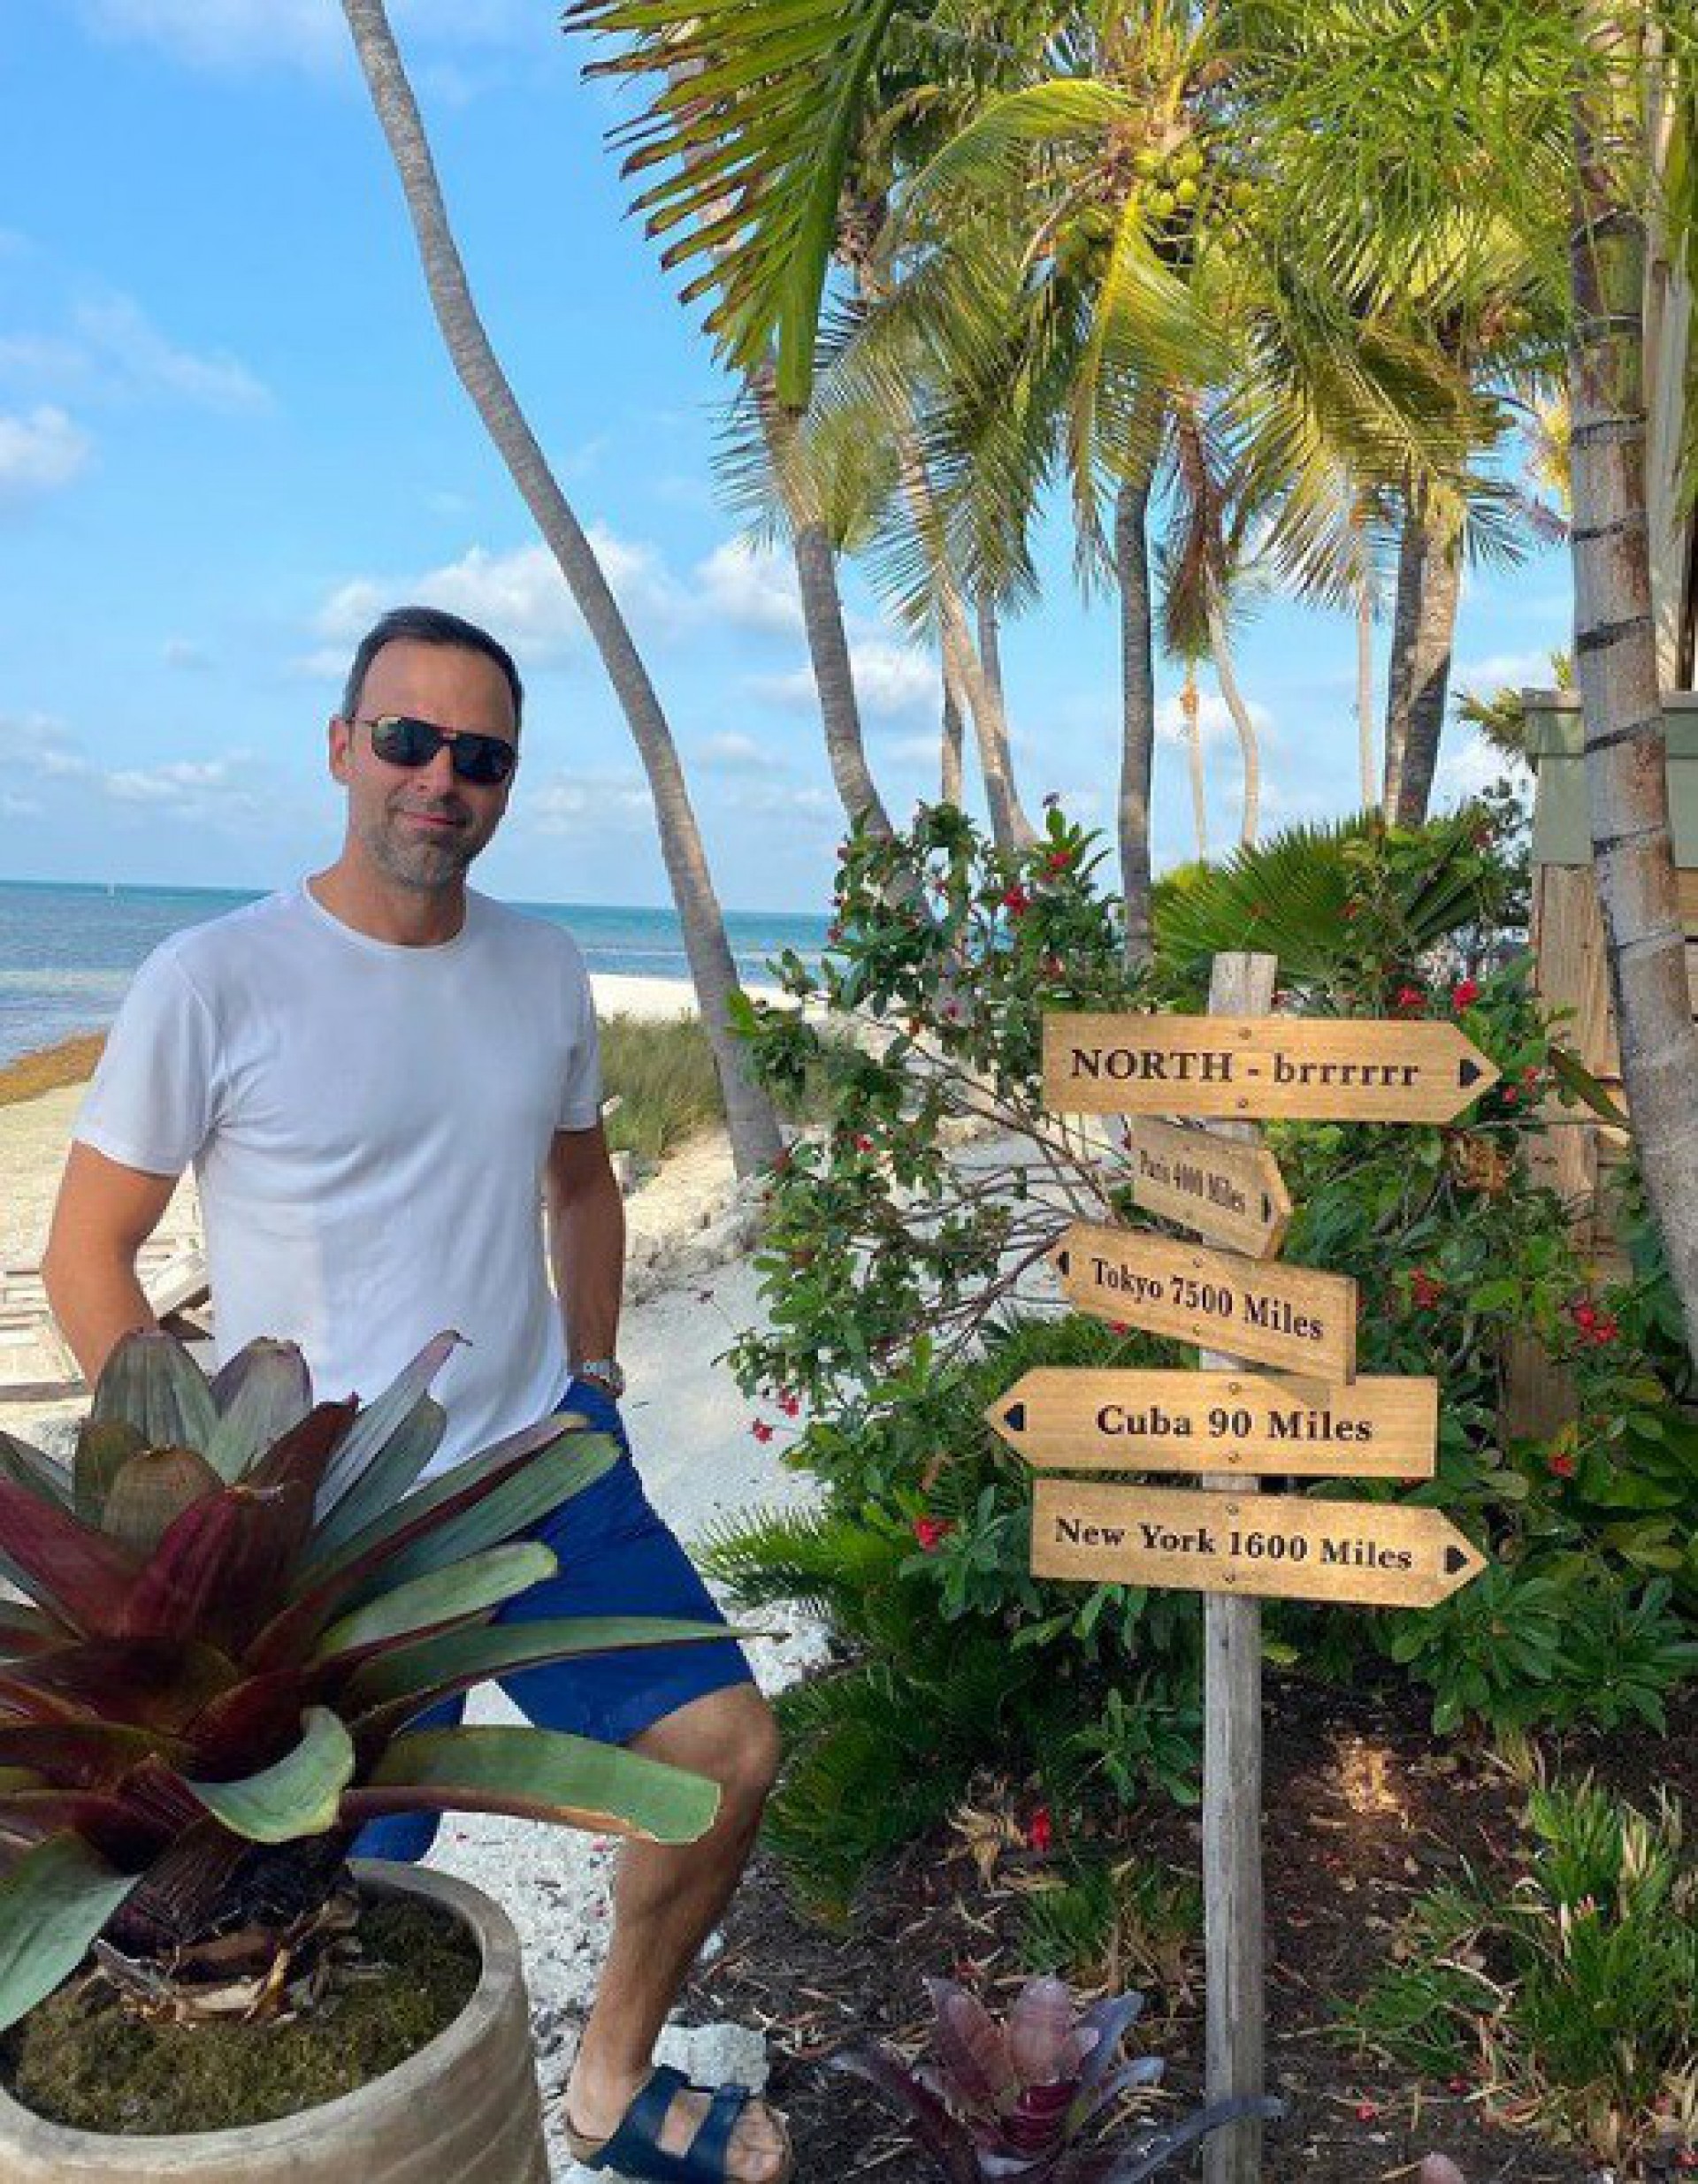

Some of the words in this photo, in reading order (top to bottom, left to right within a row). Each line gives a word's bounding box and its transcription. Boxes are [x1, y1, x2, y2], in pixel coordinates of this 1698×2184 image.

[1071, 1049, 1233, 1082] NORTH
[1274, 1052, 1419, 1086] brrrrrr
[1208, 1172, 1246, 1215] Miles
[1091, 1258, 1164, 1304] Tokyo
[1170, 1275, 1233, 1317] 7500
[1244, 1294, 1324, 1340] Miles
[1097, 1404, 1191, 1435] Cuba
[1208, 1408, 1252, 1438] 90
[1267, 1411, 1373, 1441] Miles
[1055, 1516, 1125, 1546] New
[1138, 1523, 1216, 1554] York
[1228, 1531, 1308, 1562] 1600
[1320, 1539, 1412, 1569] Miles
